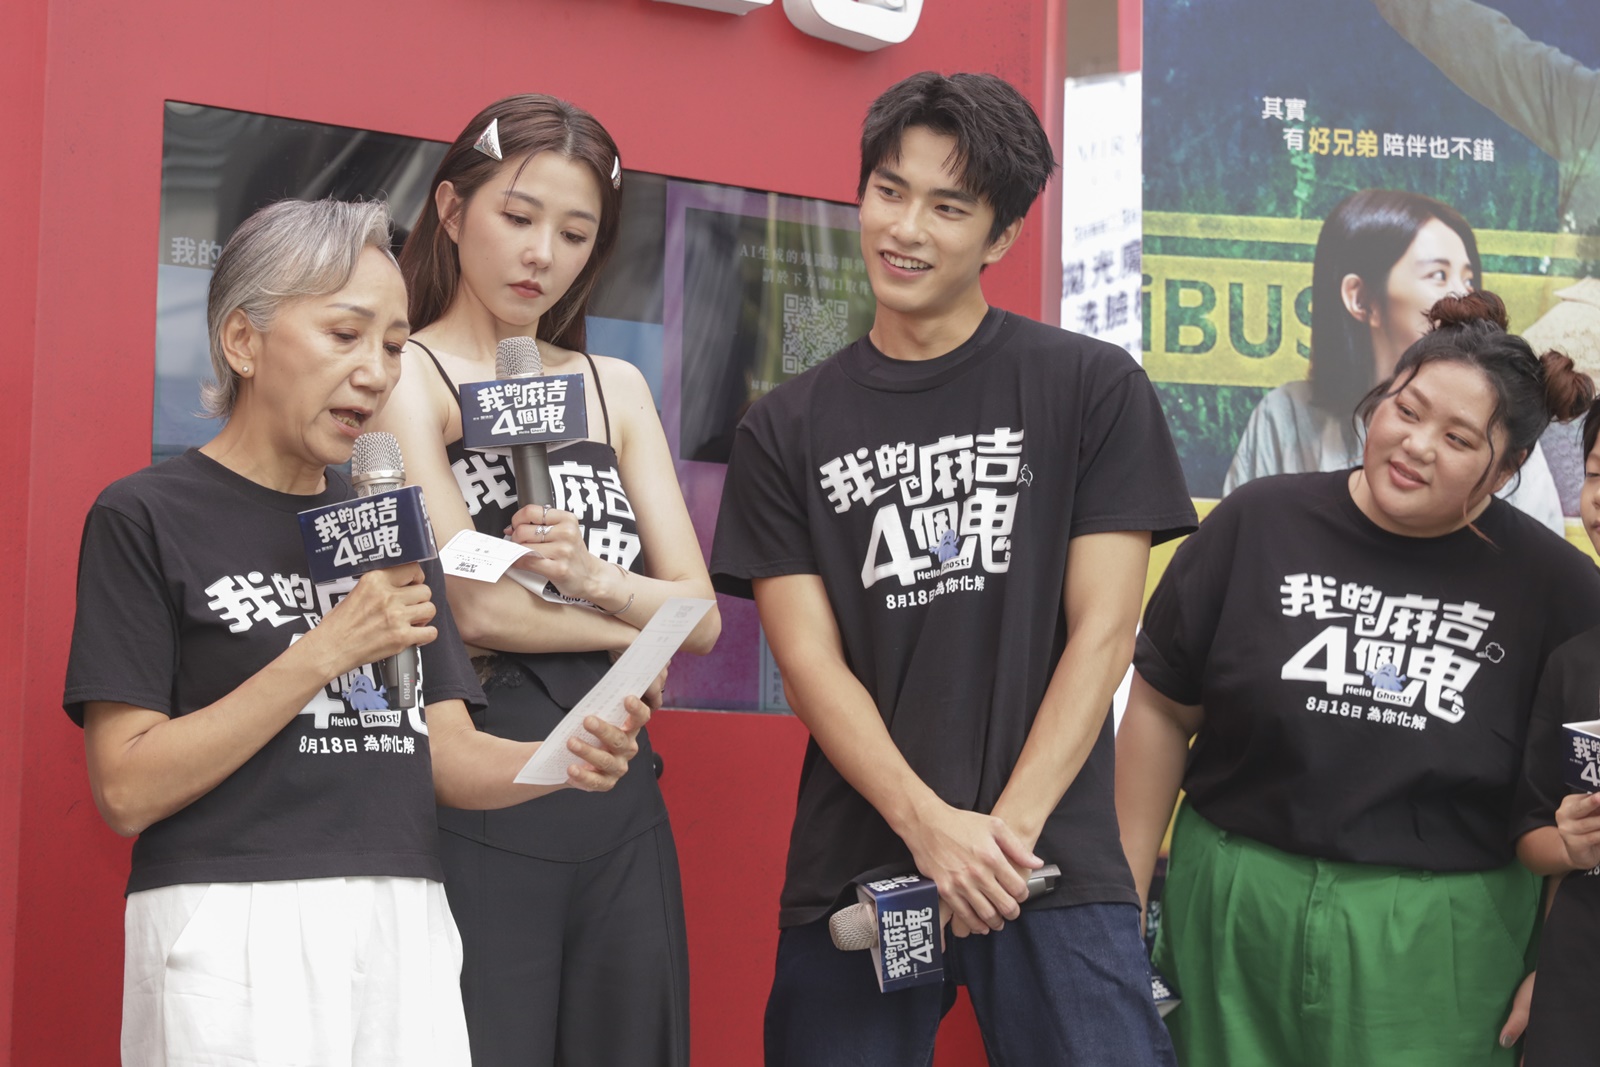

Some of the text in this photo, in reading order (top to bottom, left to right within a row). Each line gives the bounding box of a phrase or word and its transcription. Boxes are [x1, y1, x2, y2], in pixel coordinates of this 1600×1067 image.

[1262, 96, 1307, 122] 其實
[171, 236, 222, 267] 我的
[477, 379, 568, 413] 我的麻吉
[491, 404, 566, 436] 4個鬼
[451, 453, 637, 522] 我麻吉
[819, 427, 1024, 514] 我的麻吉
[314, 496, 398, 544] 我的麻吉
[861, 487, 1020, 590] 4個鬼
[333, 525, 402, 567] 4個鬼
[917, 569, 940, 581] Hello
[1280, 573, 1496, 651] 我的麻吉
[1281, 625, 1481, 724] 4個鬼
[1345, 685, 1413, 705] Hello Ghost!
[331, 713, 400, 727] Hello Ghost!
[882, 911, 912, 979] 我的麻吉
[905, 907, 934, 964] 4個鬼
